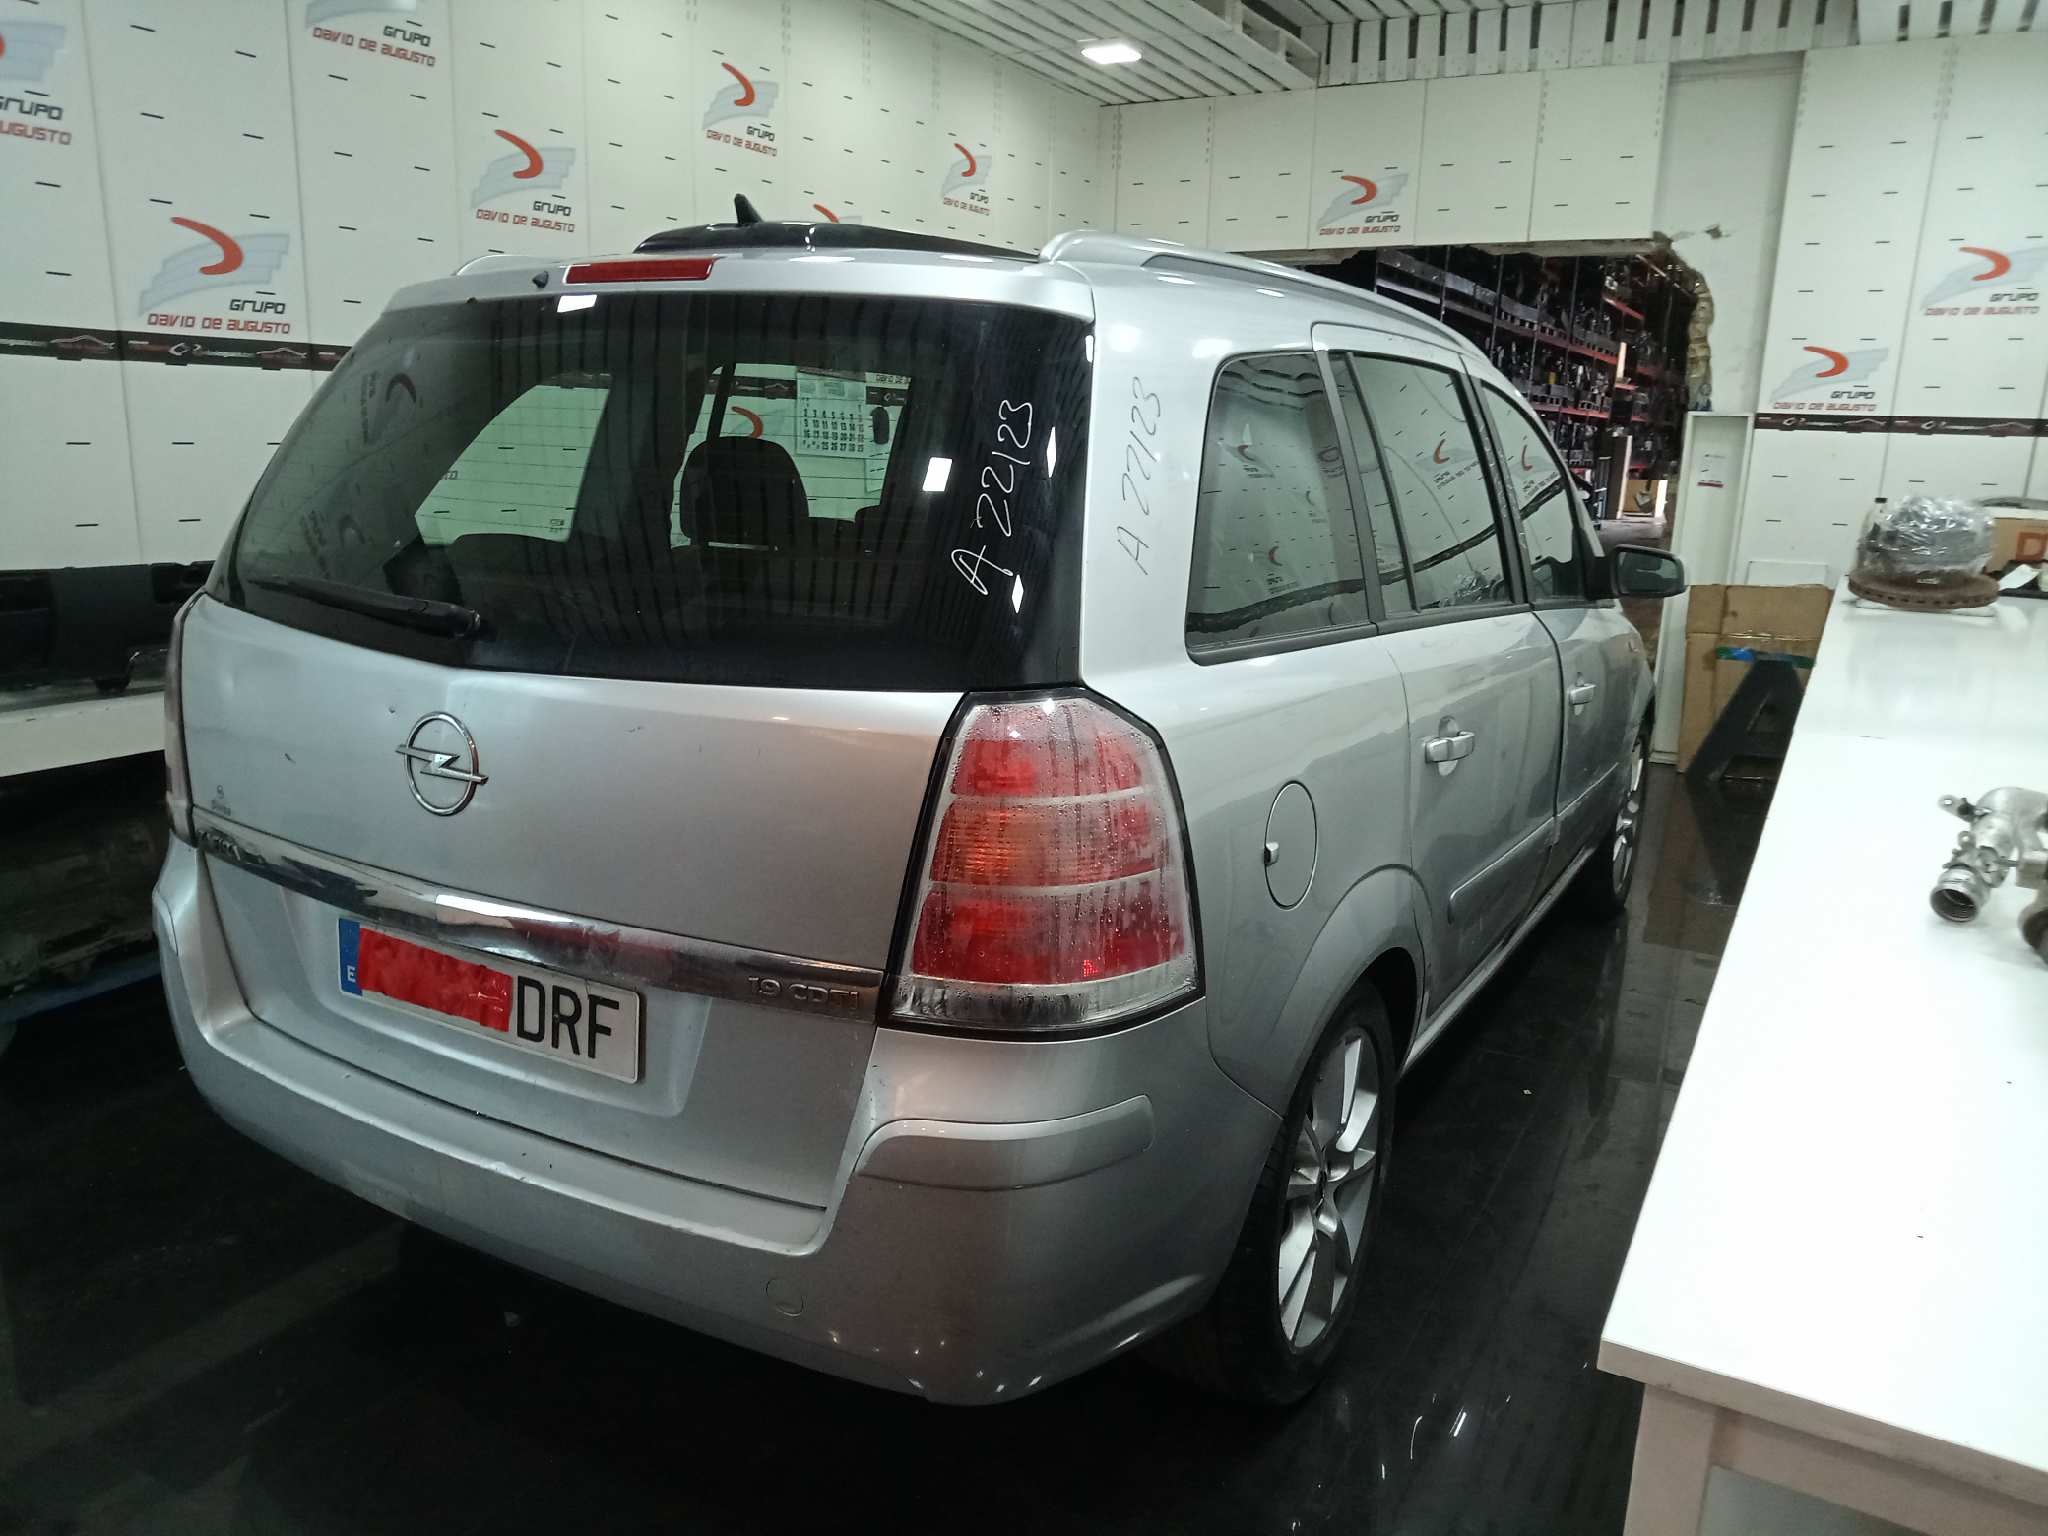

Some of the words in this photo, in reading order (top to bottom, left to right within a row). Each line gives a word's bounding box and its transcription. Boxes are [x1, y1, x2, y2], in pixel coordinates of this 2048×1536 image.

[950, 545, 1014, 595] A
[1116, 526, 1150, 576] A
[347, 965, 356, 983] E
[516, 975, 620, 1059] DRF
